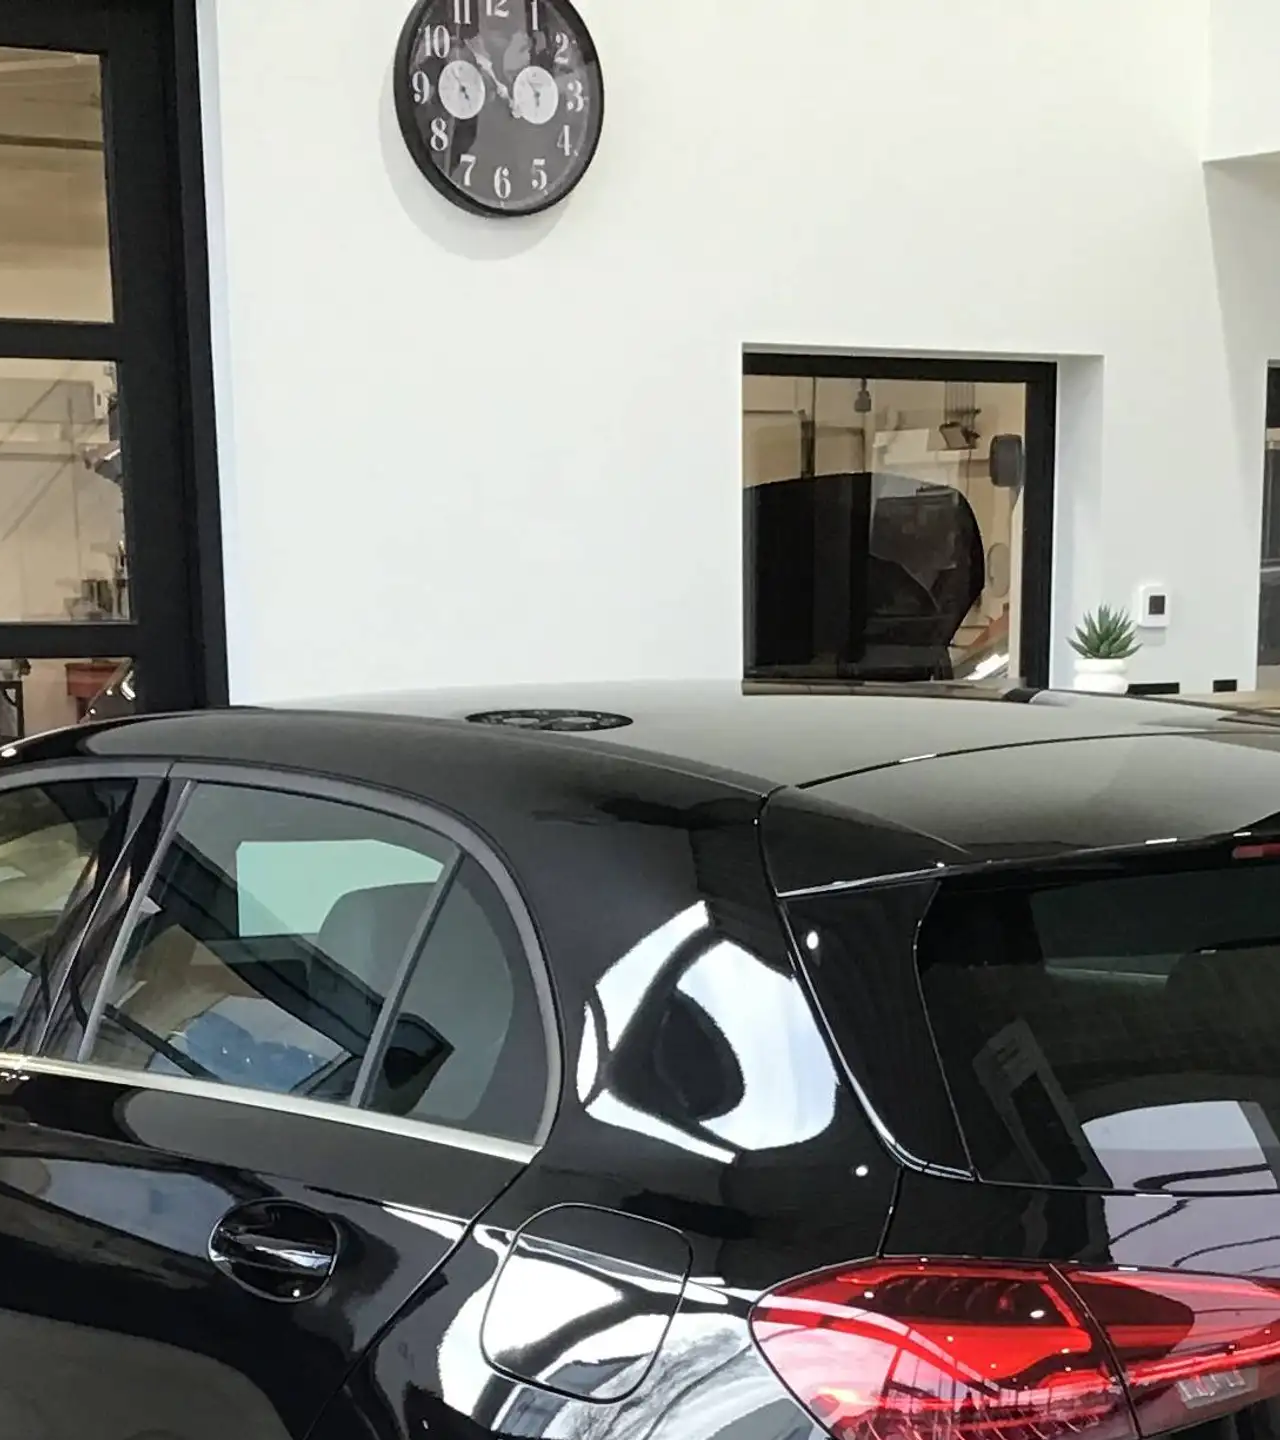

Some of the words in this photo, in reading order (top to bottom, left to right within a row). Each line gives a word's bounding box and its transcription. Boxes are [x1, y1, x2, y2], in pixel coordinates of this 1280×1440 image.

[454, 0, 471, 24] 11
[531, 0, 539, 30] 1
[424, 25, 451, 58] 10
[554, 33, 569, 64] 2
[412, 71, 430, 104] 9
[567, 80, 584, 112] 3
[430, 117, 448, 151] 8
[557, 125, 572, 156] 4
[460, 154, 476, 186] 7
[494, 166, 511, 199] 6
[532, 159, 547, 190] 5
